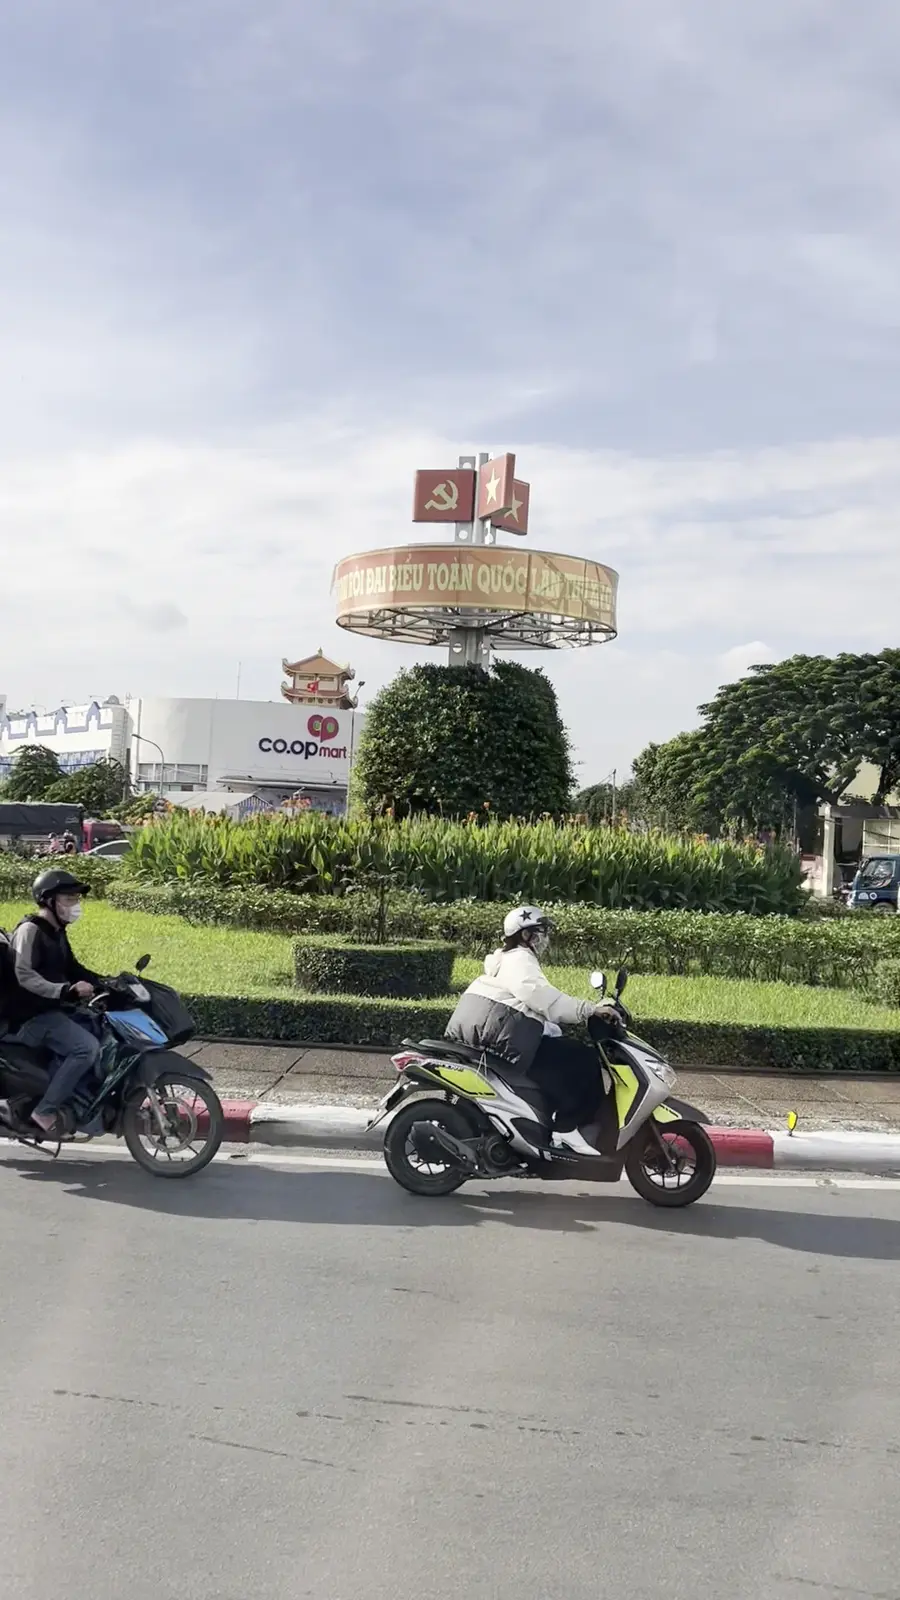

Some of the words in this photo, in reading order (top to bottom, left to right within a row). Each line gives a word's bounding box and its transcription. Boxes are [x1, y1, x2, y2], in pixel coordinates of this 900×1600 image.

[388, 553, 424, 592] BIỂU
[427, 556, 474, 591] TOÀN
[477, 557, 527, 595] QUỐC
